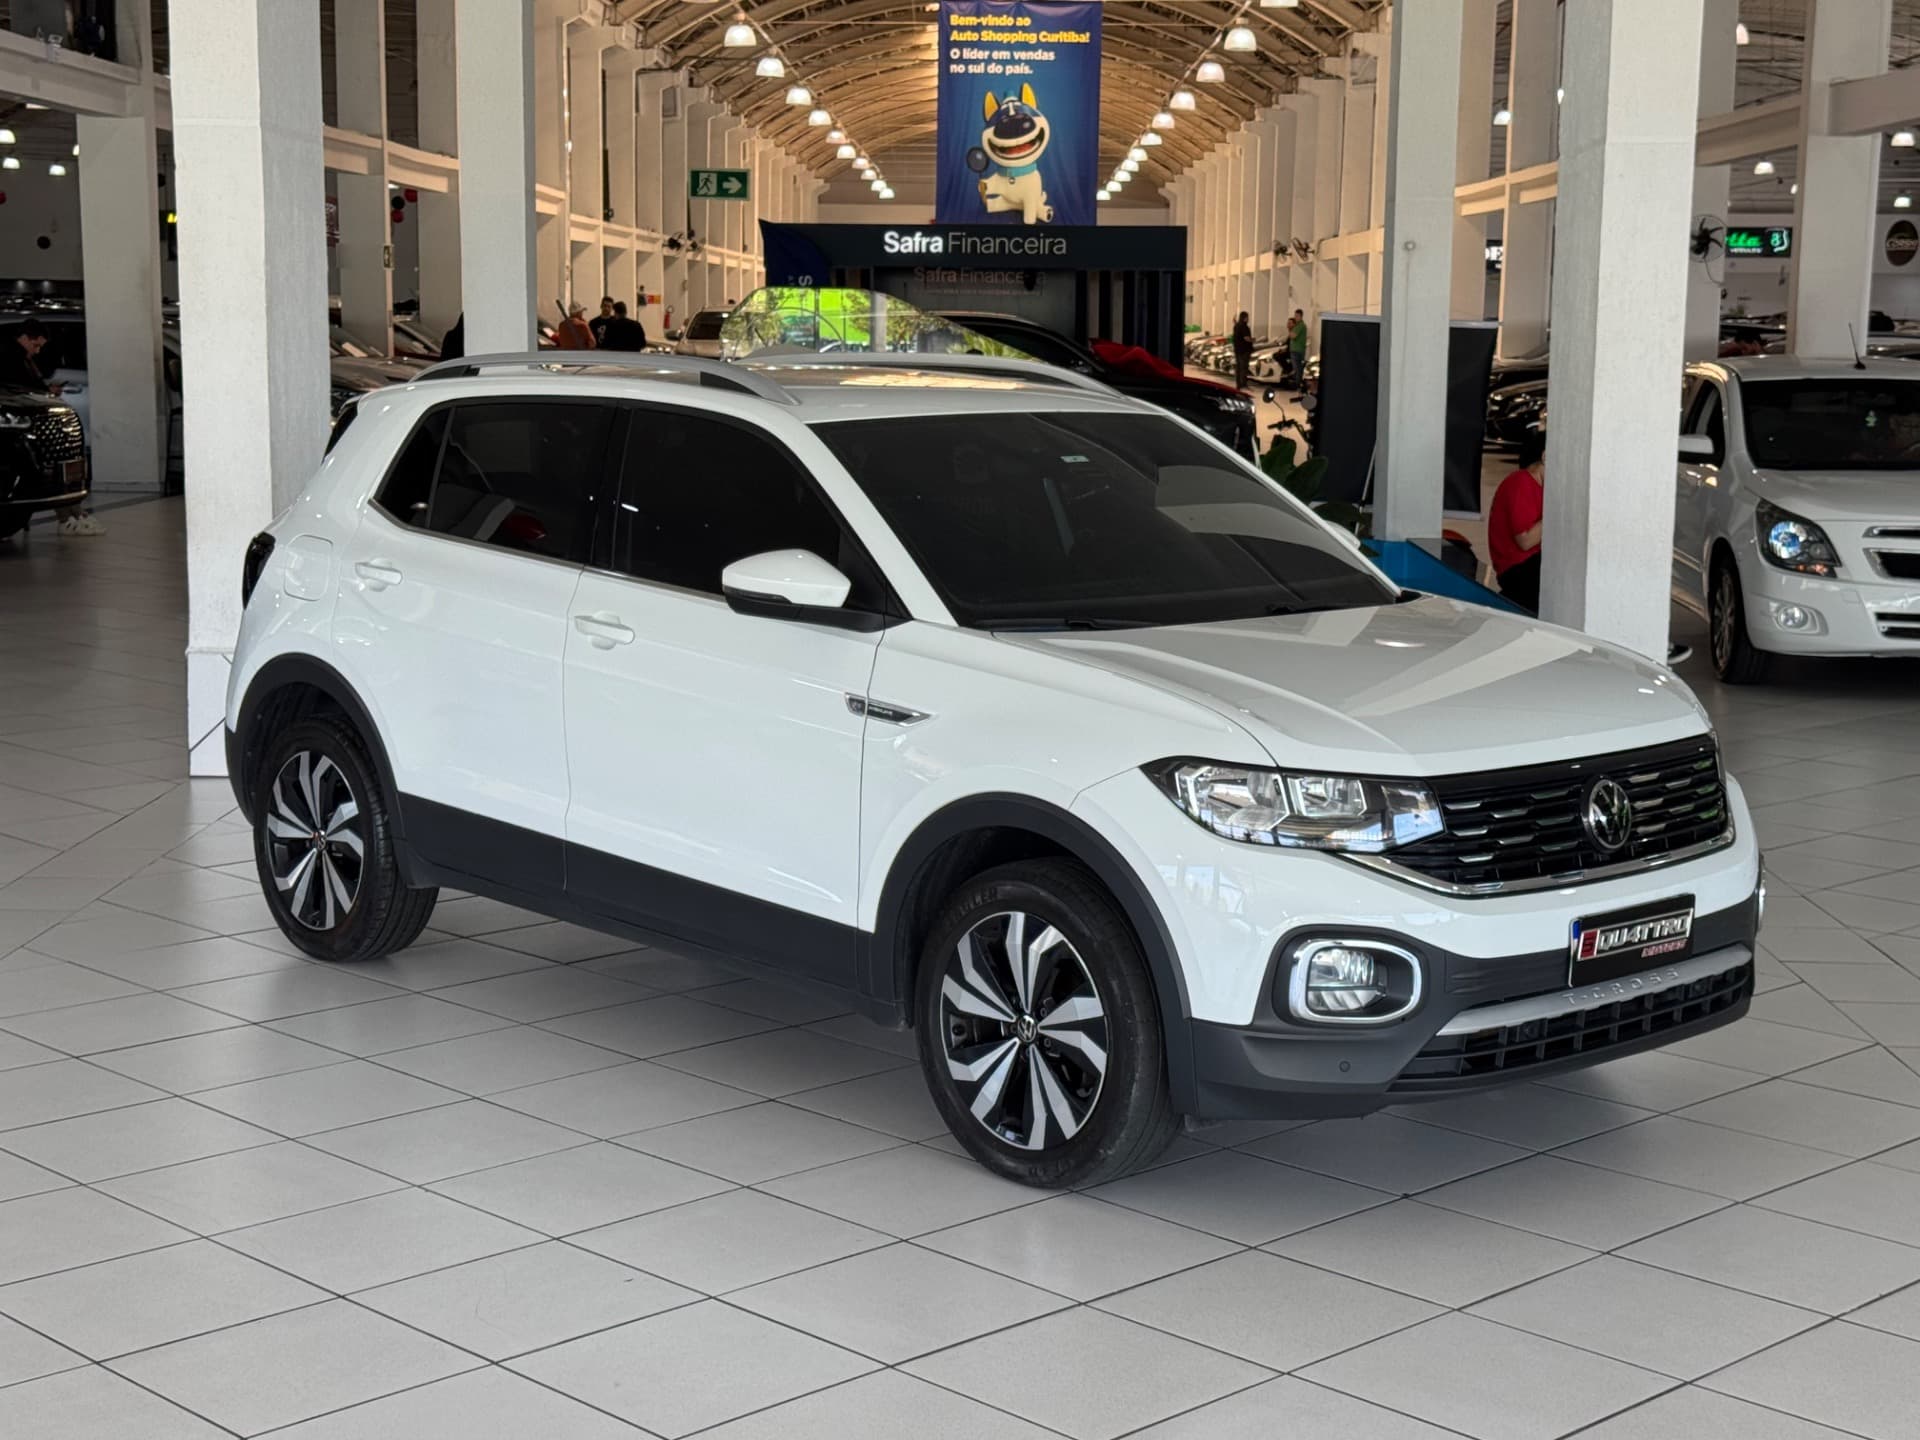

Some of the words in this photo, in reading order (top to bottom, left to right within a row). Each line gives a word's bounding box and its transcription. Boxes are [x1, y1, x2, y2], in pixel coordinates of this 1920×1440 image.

[950, 15, 1014, 26] Bem-vindo
[1016, 17, 1031, 26] ao
[950, 30, 979, 41] Auto
[981, 30, 1037, 44] Shopping
[1039, 31, 1090, 43] Curitiba!
[950, 48, 960, 59] O
[963, 48, 989, 59] líder
[992, 50, 1010, 59] em
[1013, 49, 1055, 60] vendas
[950, 64, 965, 73] no
[968, 63, 984, 73] sul
[987, 63, 1003, 73] do
[883, 231, 943, 253] Safra
[948, 232, 1067, 255] Financeira
[913, 266, 957, 283] Safra
